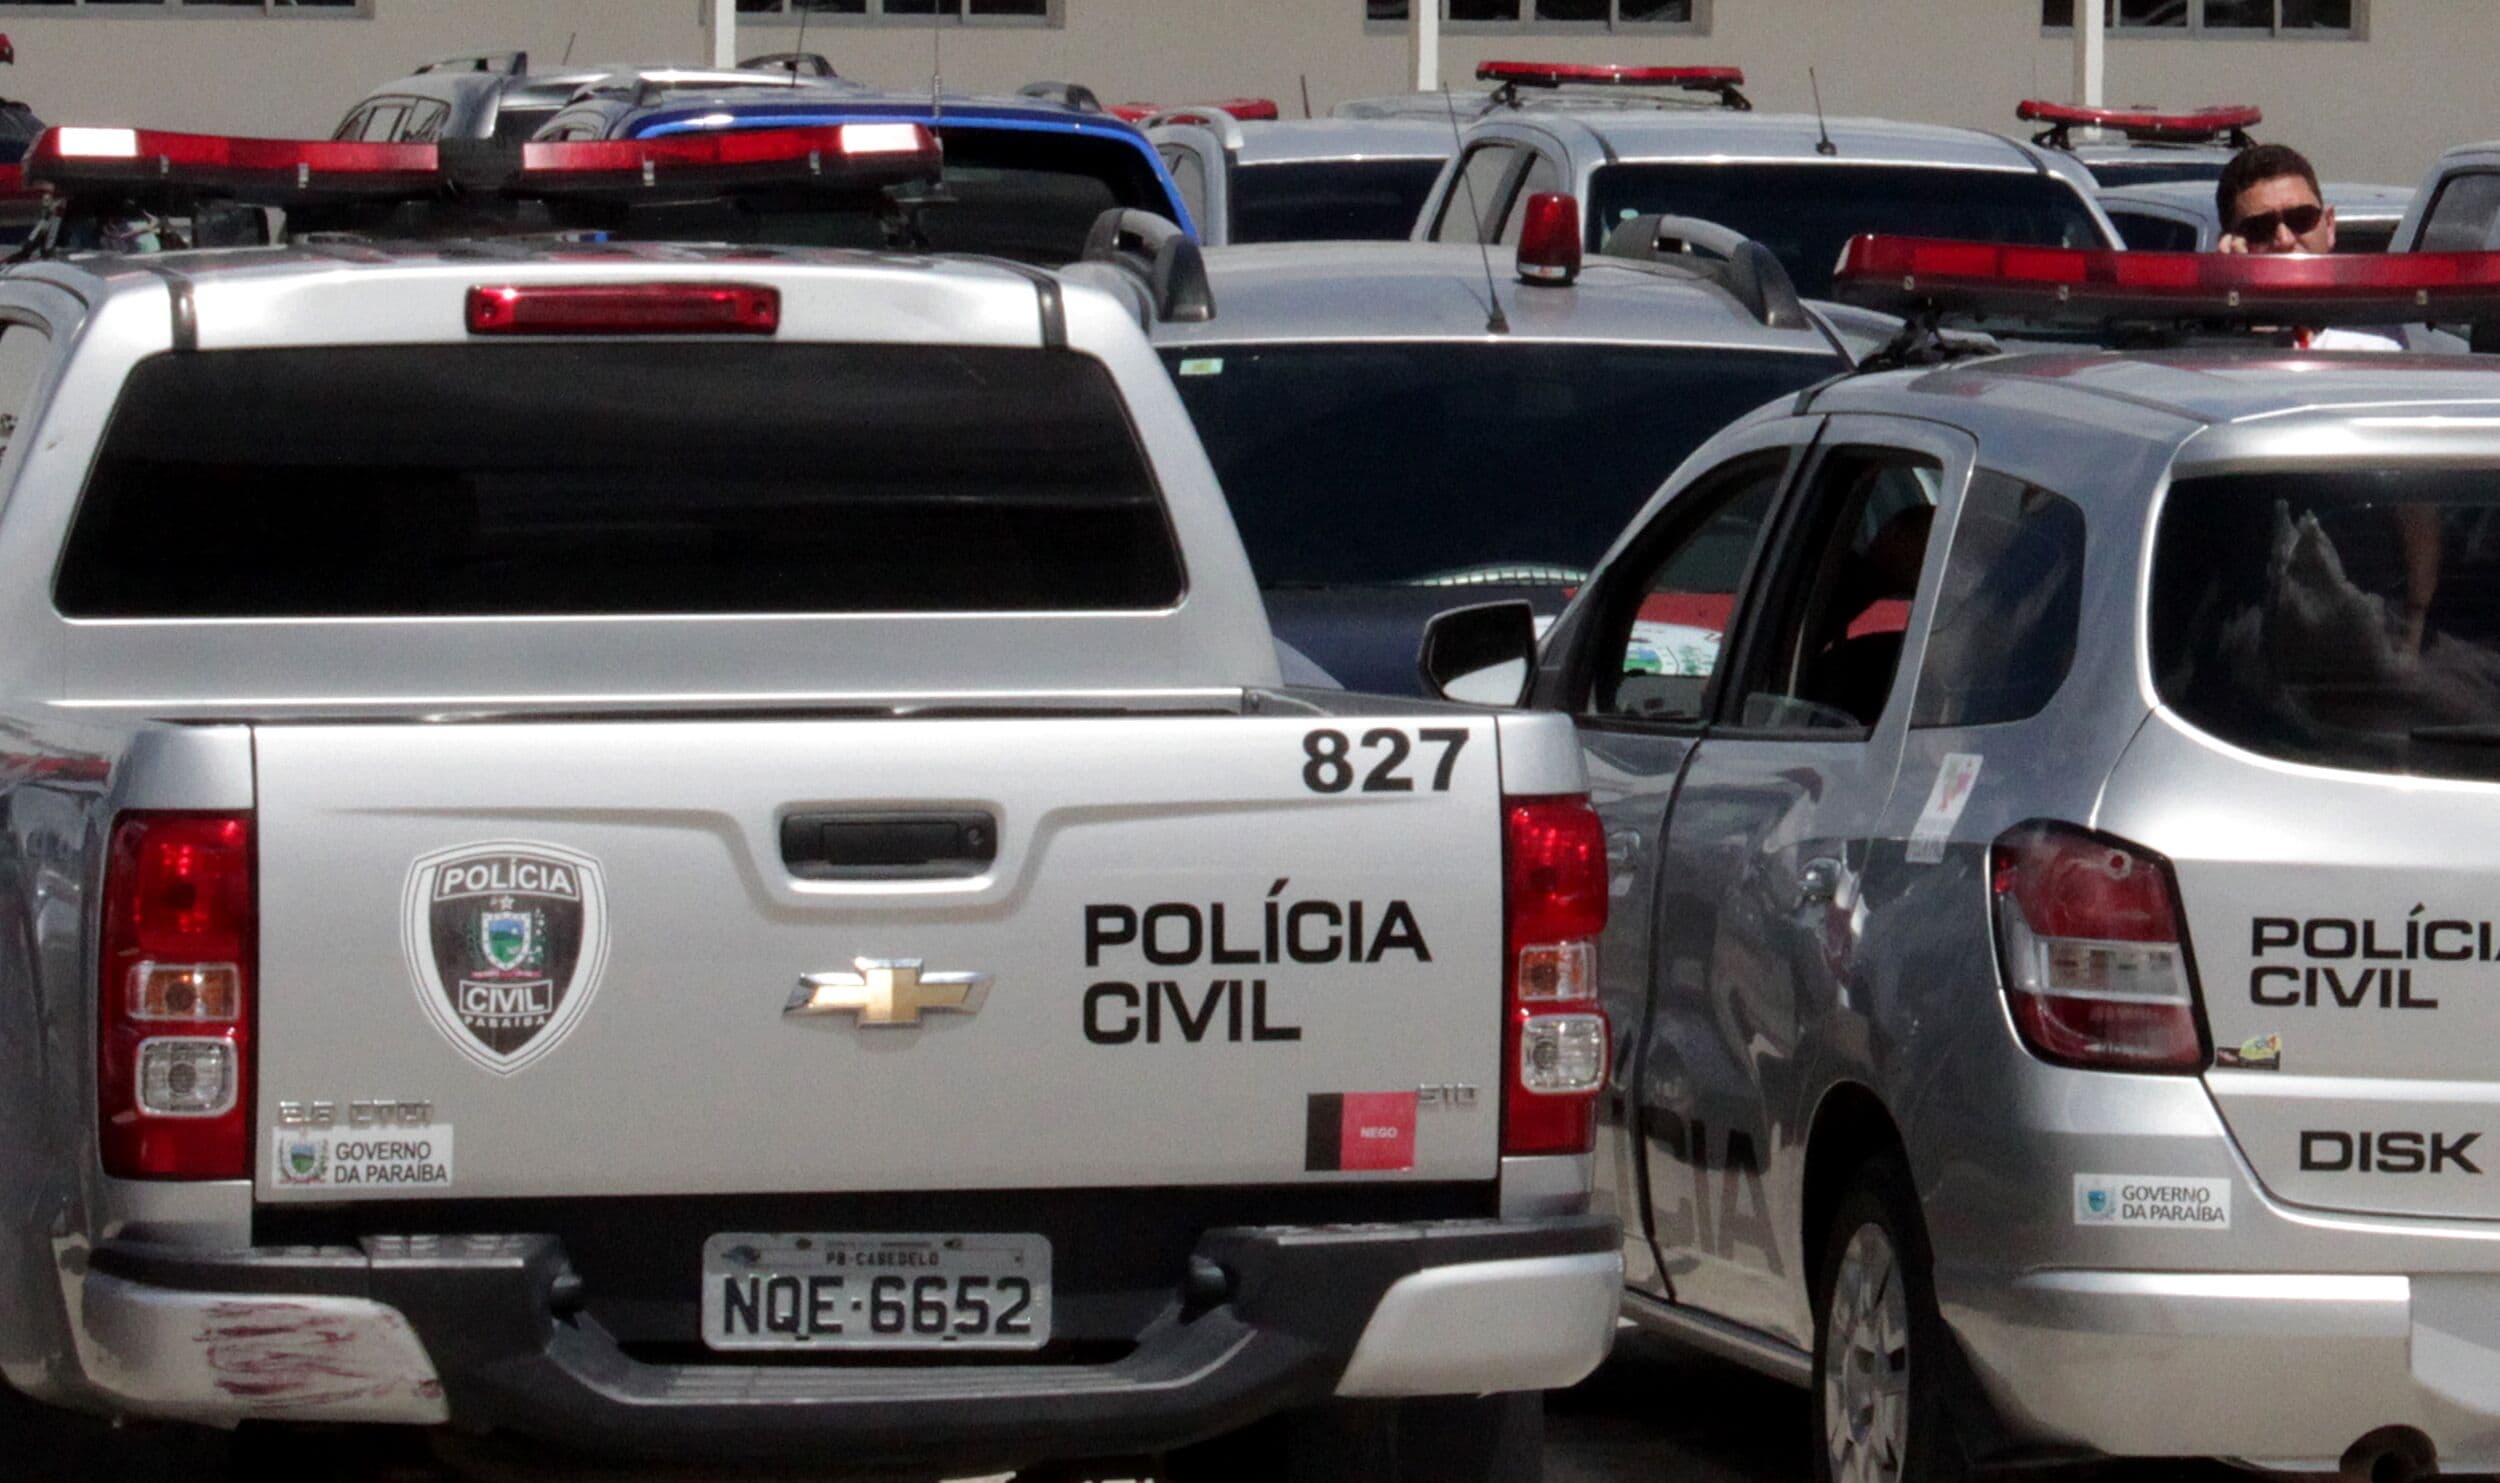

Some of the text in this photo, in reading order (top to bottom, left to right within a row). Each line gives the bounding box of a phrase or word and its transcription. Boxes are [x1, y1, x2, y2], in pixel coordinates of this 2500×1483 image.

[1303, 728, 1469, 793] 827
[442, 856, 573, 894] POLÍCIA
[1085, 878, 1432, 967] POLÍCIA
[2251, 902, 2500, 961] POLÍCI
[467, 988, 545, 1013] CIVIL
[2250, 966, 2439, 1009] CIVIL
[1083, 980, 1302, 1044] CIVIL
[336, 1142, 431, 1161] GOVERNO
[1360, 1126, 1398, 1139] NEGO
[334, 1159, 448, 1184] DA PARAÍBA
[2300, 1130, 2483, 1175] DISK
[2122, 1185, 2210, 1203] GOVERNO
[2122, 1201, 2225, 1222] DA PARAÍBA
